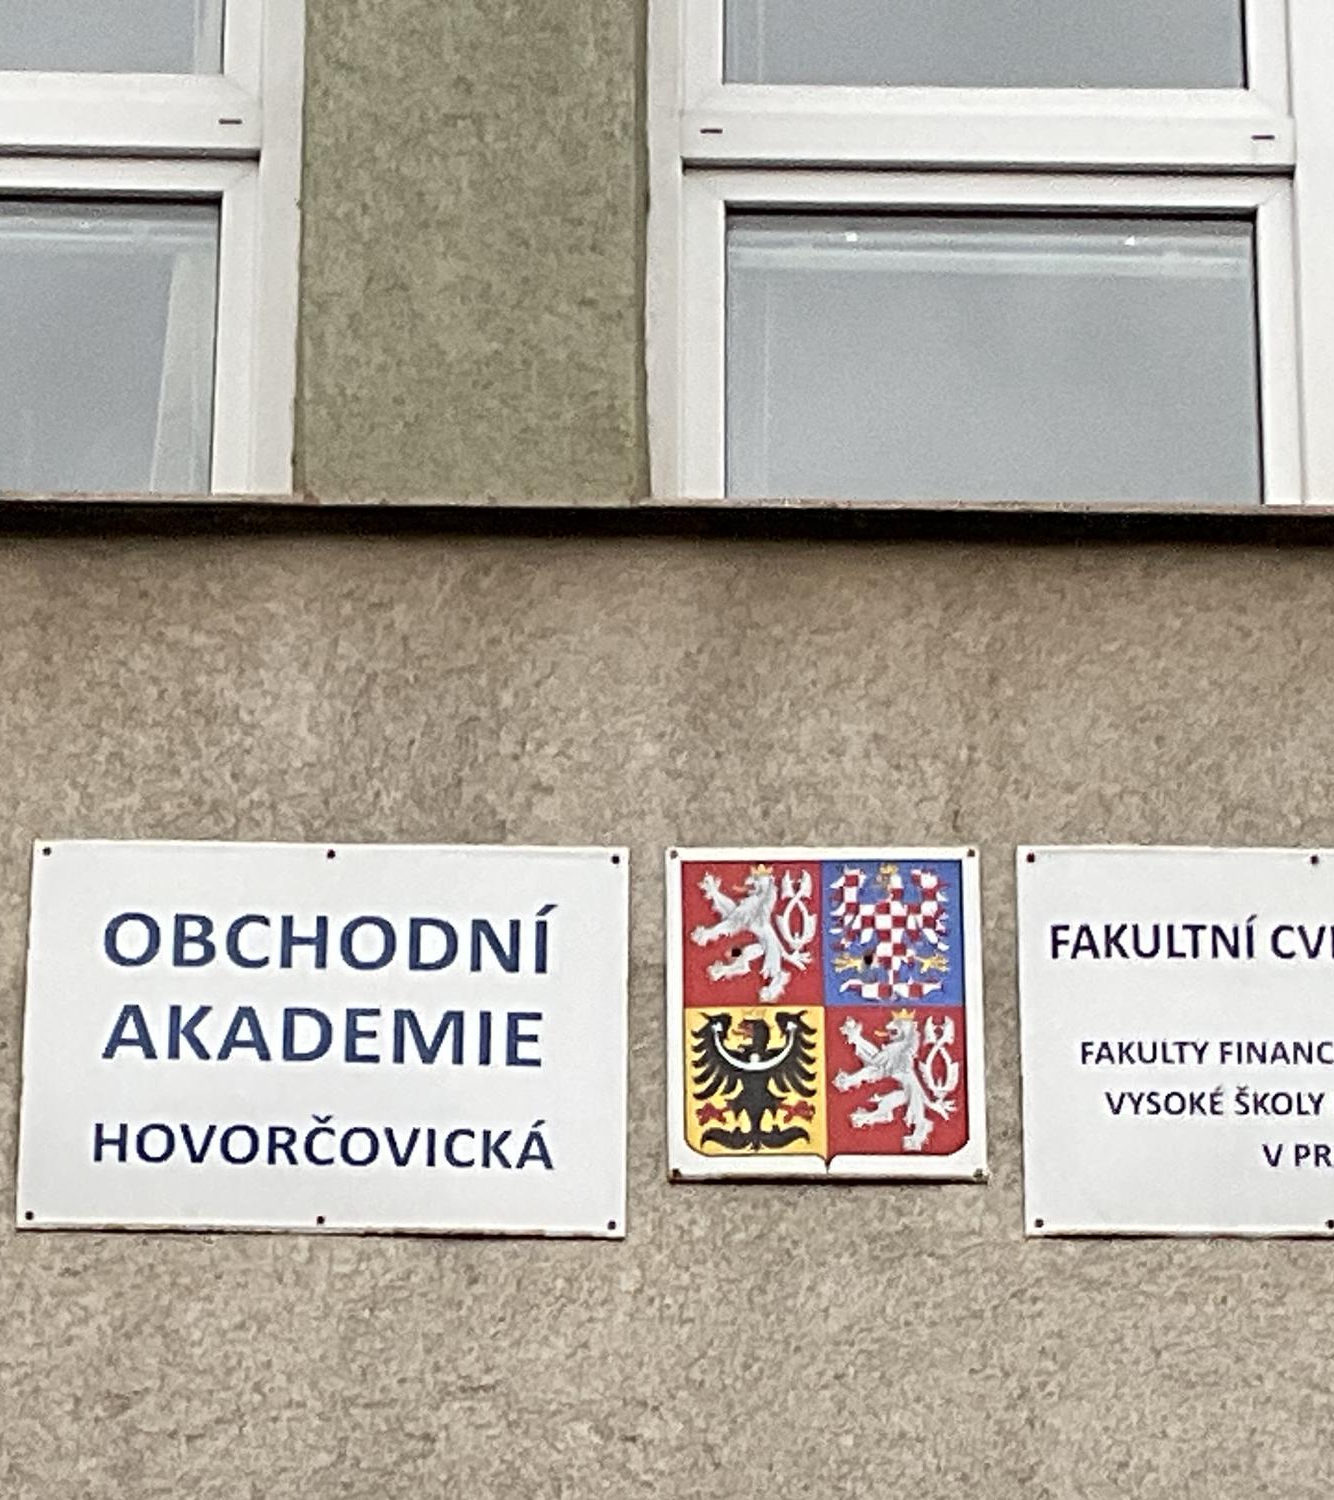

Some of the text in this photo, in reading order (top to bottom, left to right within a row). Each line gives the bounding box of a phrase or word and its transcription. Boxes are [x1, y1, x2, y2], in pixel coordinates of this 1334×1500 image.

[103, 904, 558, 974] OBCHODNÍ
[1050, 914, 1257, 960] FAKULTNÍ
[102, 1004, 543, 1067] AKADEMIE
[1081, 1041, 1209, 1065] FAKULTY
[1105, 1086, 1225, 1116] VYSOKÉ
[1234, 1086, 1325, 1116] ŠKOLY
[93, 1114, 555, 1170] HOVORČOVICKÁ
[1262, 1143, 1283, 1168] V
